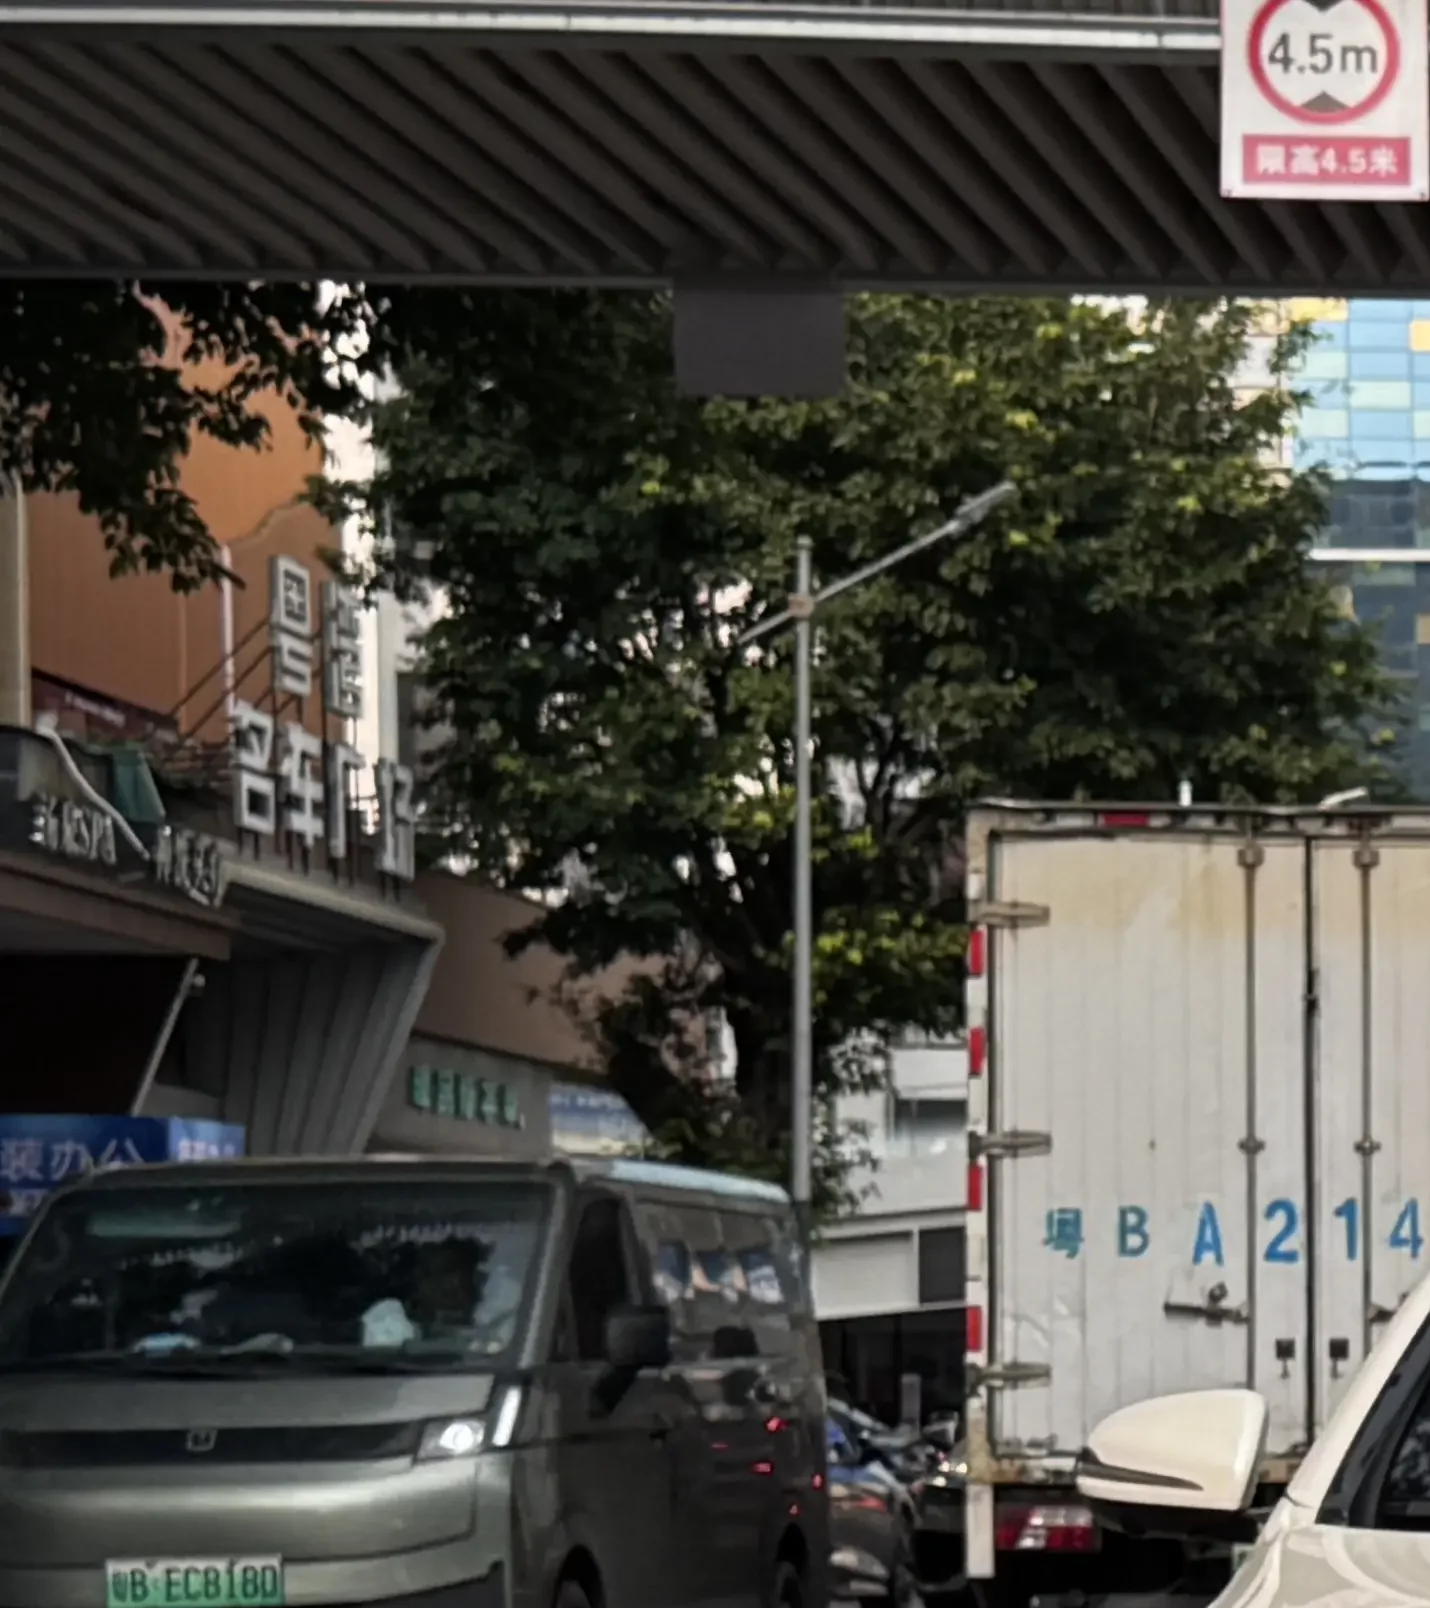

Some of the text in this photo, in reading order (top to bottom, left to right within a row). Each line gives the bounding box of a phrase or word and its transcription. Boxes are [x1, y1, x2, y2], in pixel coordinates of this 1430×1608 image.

[1267, 33, 1378, 75] 4.5m
[1255, 143, 1398, 178] 限高4.5米
